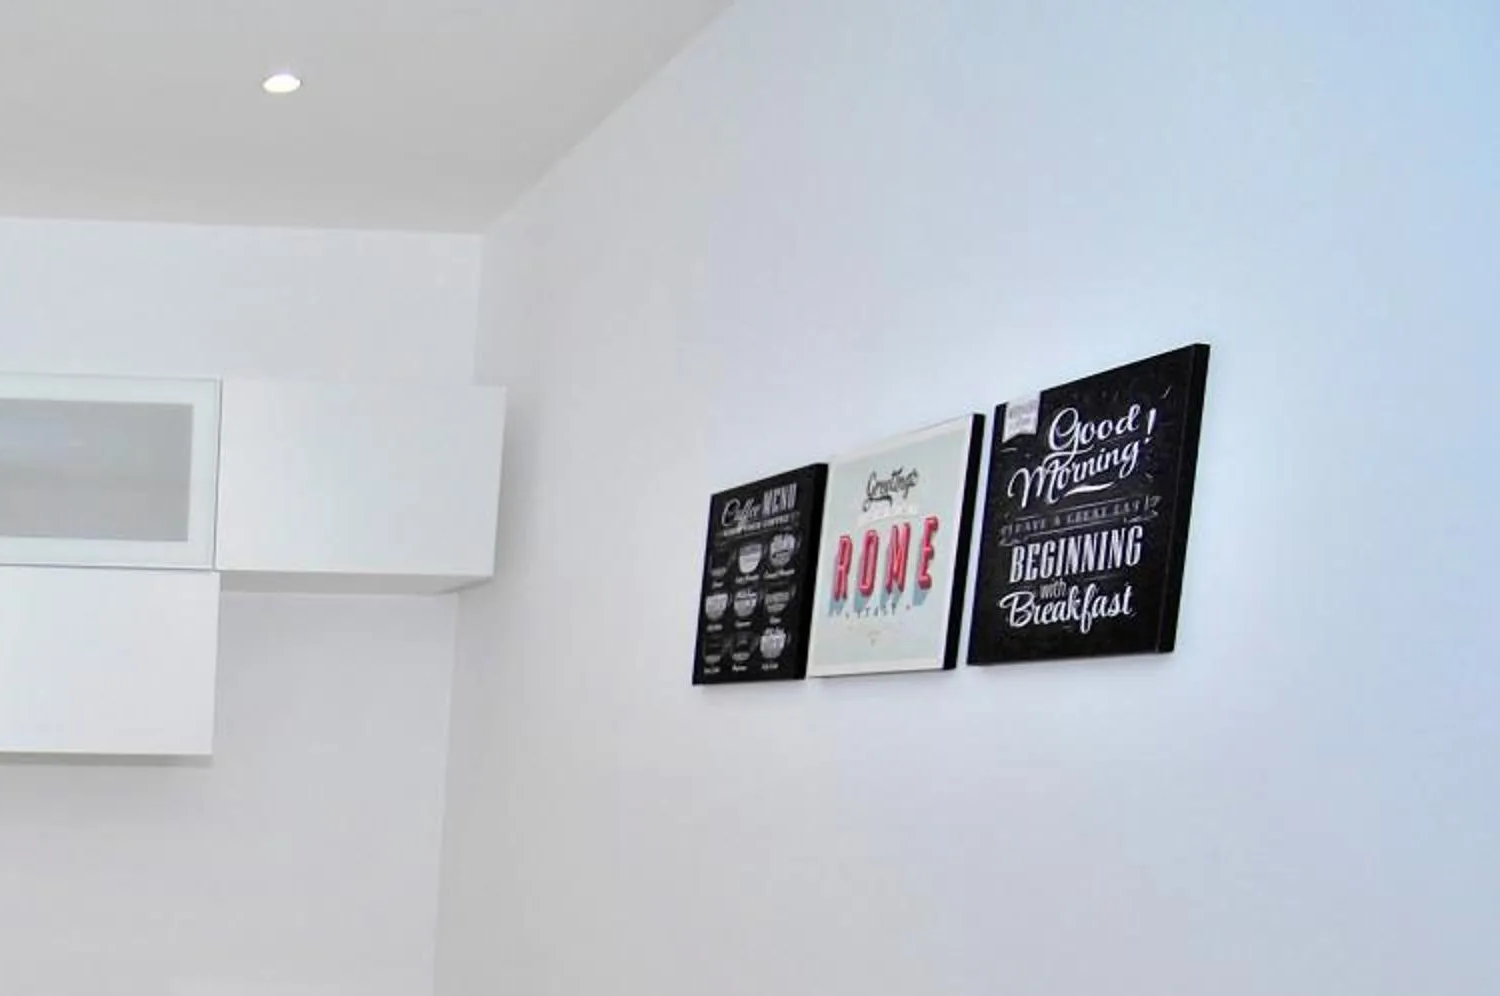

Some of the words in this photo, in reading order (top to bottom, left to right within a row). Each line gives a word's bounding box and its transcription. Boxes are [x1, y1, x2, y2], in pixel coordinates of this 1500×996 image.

[1049, 403, 1141, 468] Good
[762, 482, 798, 518] MENU
[832, 515, 938, 602] ROME
[1009, 525, 1143, 584] BEGINNING
[999, 583, 1133, 635] Breakfast
